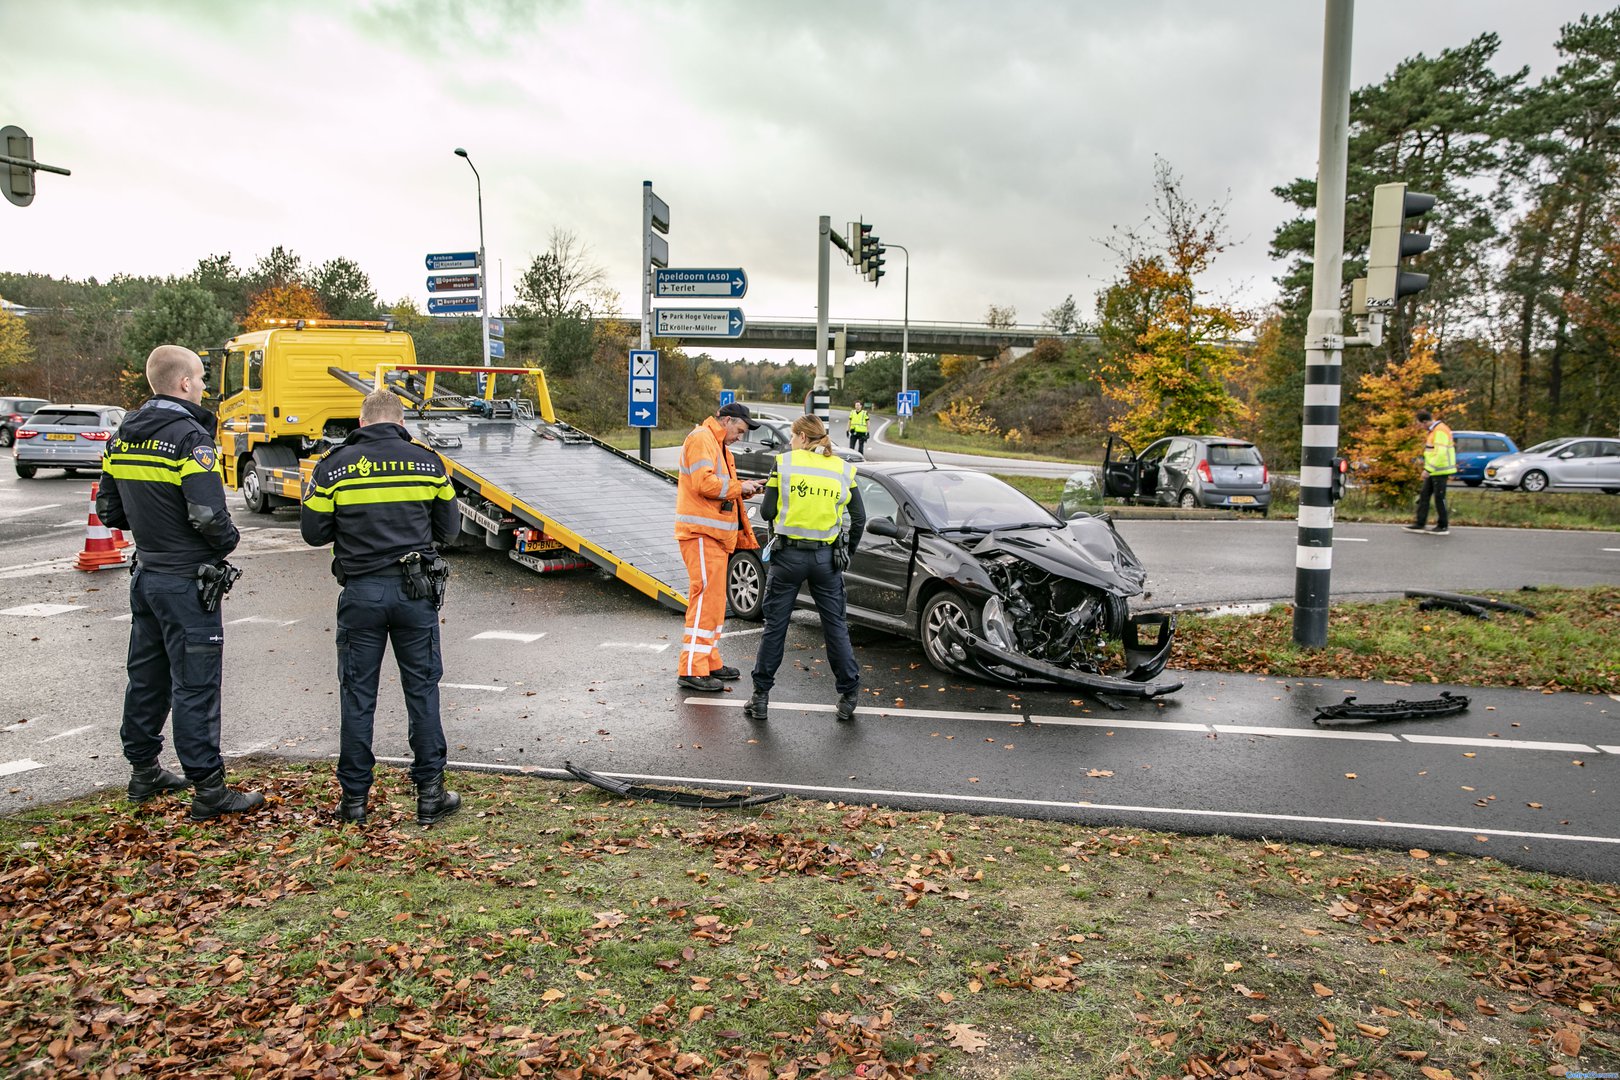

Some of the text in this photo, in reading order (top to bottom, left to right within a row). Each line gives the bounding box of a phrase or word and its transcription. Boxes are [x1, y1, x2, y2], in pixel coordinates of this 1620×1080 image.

[659, 273, 730, 281] Apeldoorn (A50)
[671, 284, 695, 292] Terlet
[347, 456, 416, 477] POLITIE
[790, 479, 841, 500] POLITIE
